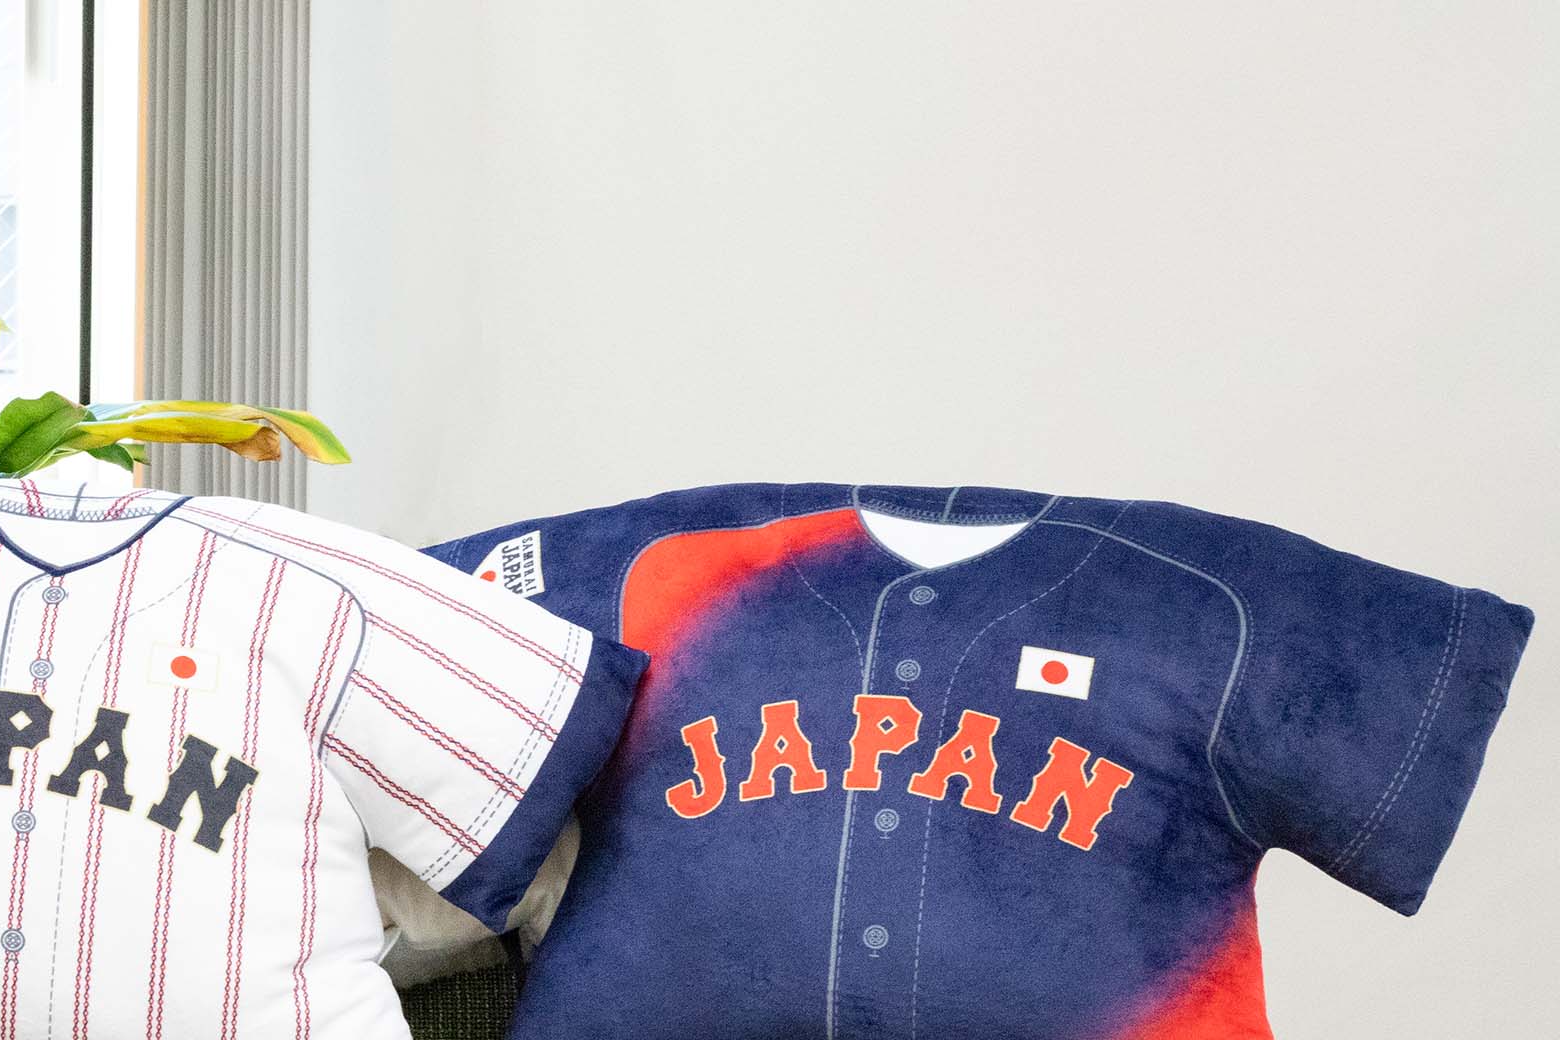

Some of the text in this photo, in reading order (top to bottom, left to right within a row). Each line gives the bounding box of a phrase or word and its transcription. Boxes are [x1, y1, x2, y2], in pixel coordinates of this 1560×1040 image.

[501, 545, 524, 595] JAPAN
[522, 536, 537, 593] SAMURAI
[665, 693, 1134, 852] JAPAN
